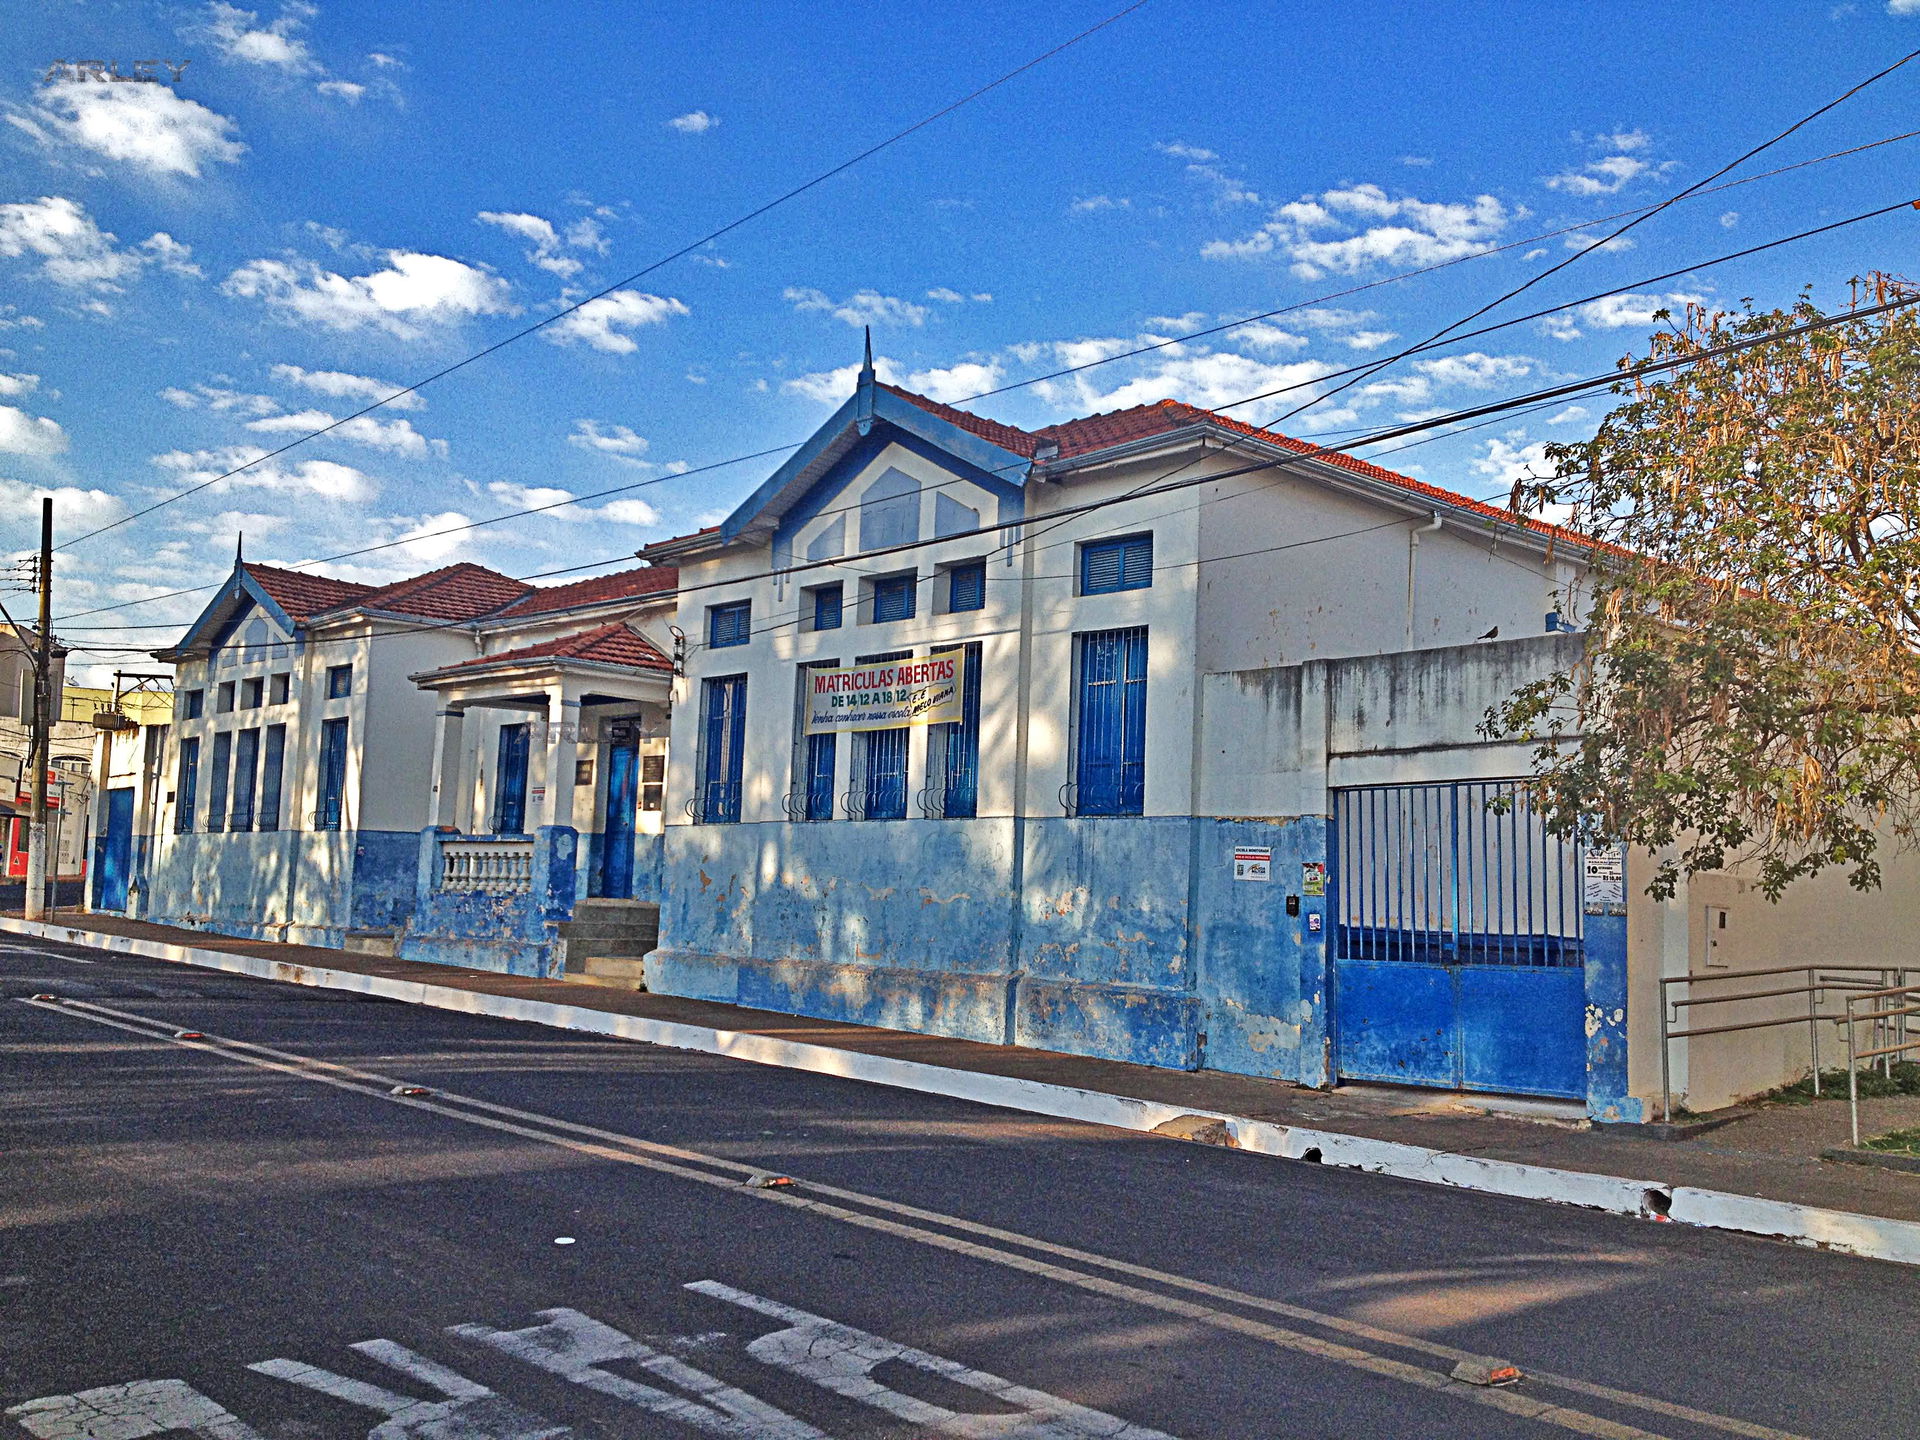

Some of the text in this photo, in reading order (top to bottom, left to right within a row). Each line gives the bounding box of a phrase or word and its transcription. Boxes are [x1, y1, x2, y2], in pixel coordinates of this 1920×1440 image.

[814, 659, 954, 694] MATRICULAS ABERTAS
[832, 695, 844, 707] DE
[872, 692, 880, 704] A
[912, 686, 954, 714] MELO VIANA
[1587, 866, 1598, 874] 10
